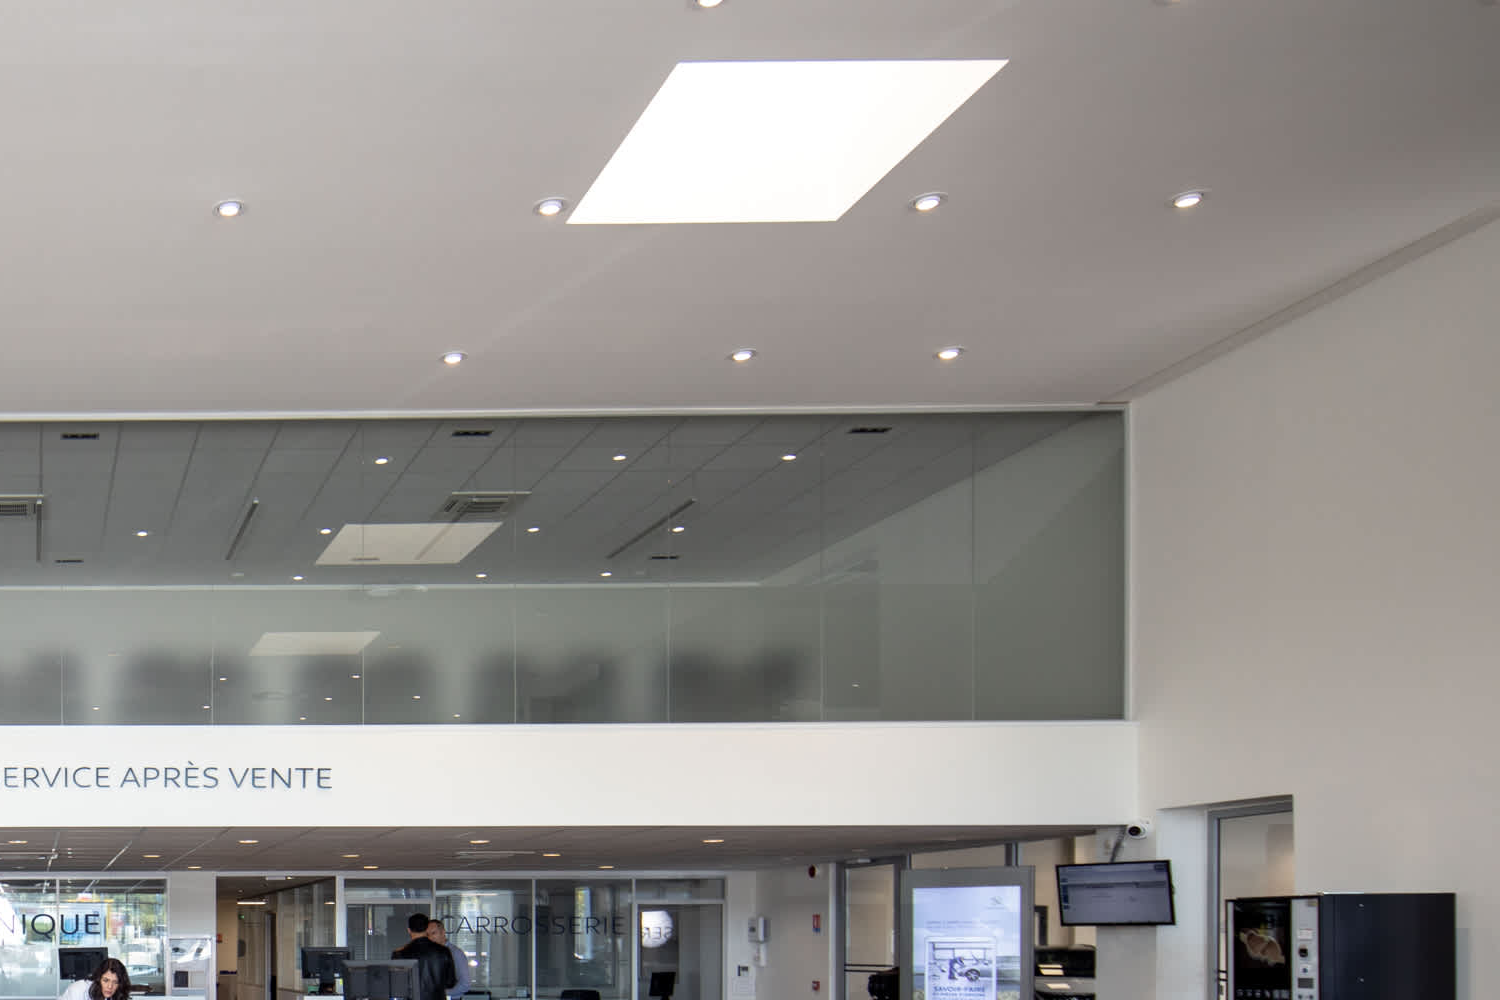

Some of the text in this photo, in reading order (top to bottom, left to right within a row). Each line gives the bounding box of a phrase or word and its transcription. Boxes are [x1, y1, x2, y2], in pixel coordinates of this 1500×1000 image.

[120, 760, 219, 788] APRÈS
[228, 767, 333, 789] VENTE
[440, 915, 628, 935] CARROSSERIE
